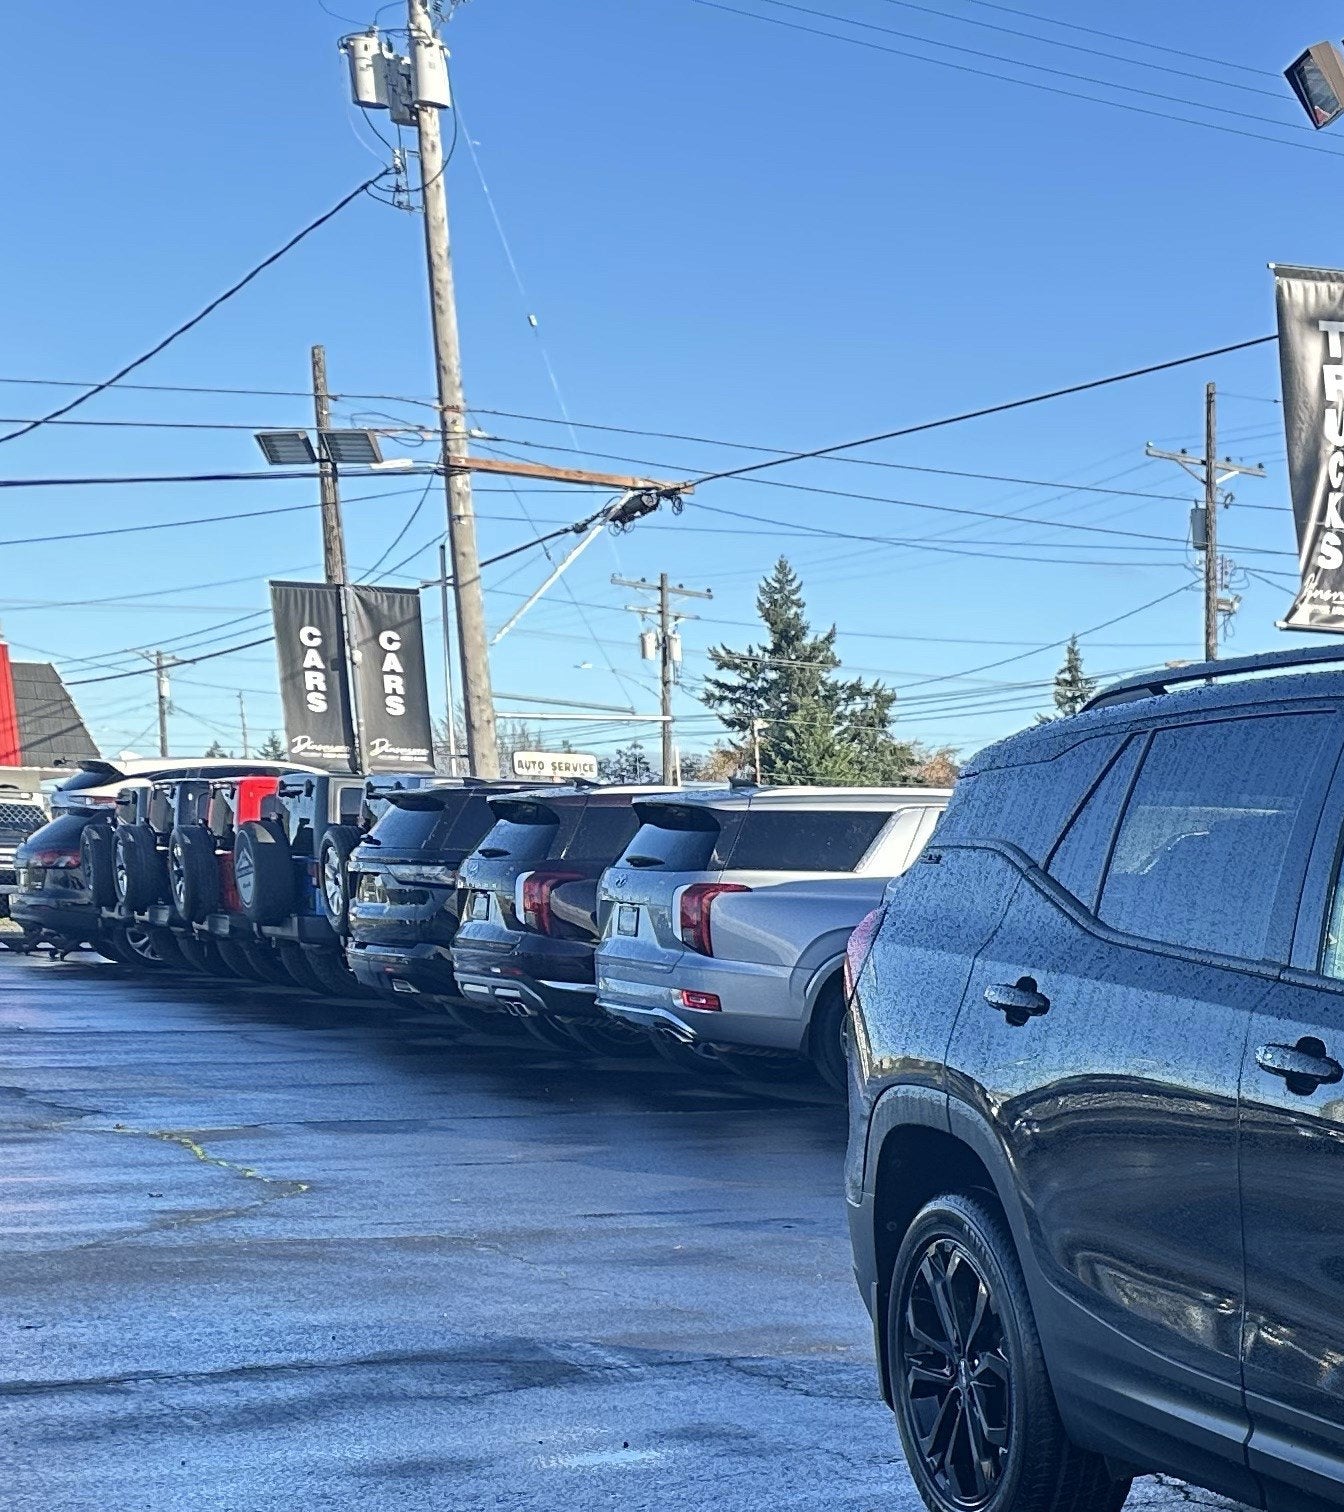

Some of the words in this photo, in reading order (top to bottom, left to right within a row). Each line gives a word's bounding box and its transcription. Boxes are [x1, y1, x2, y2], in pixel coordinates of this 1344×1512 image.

[300, 626, 328, 713] CARS
[379, 630, 406, 716] CARS
[517, 760, 545, 771] AUTO
[551, 761, 594, 773] SERVICE
